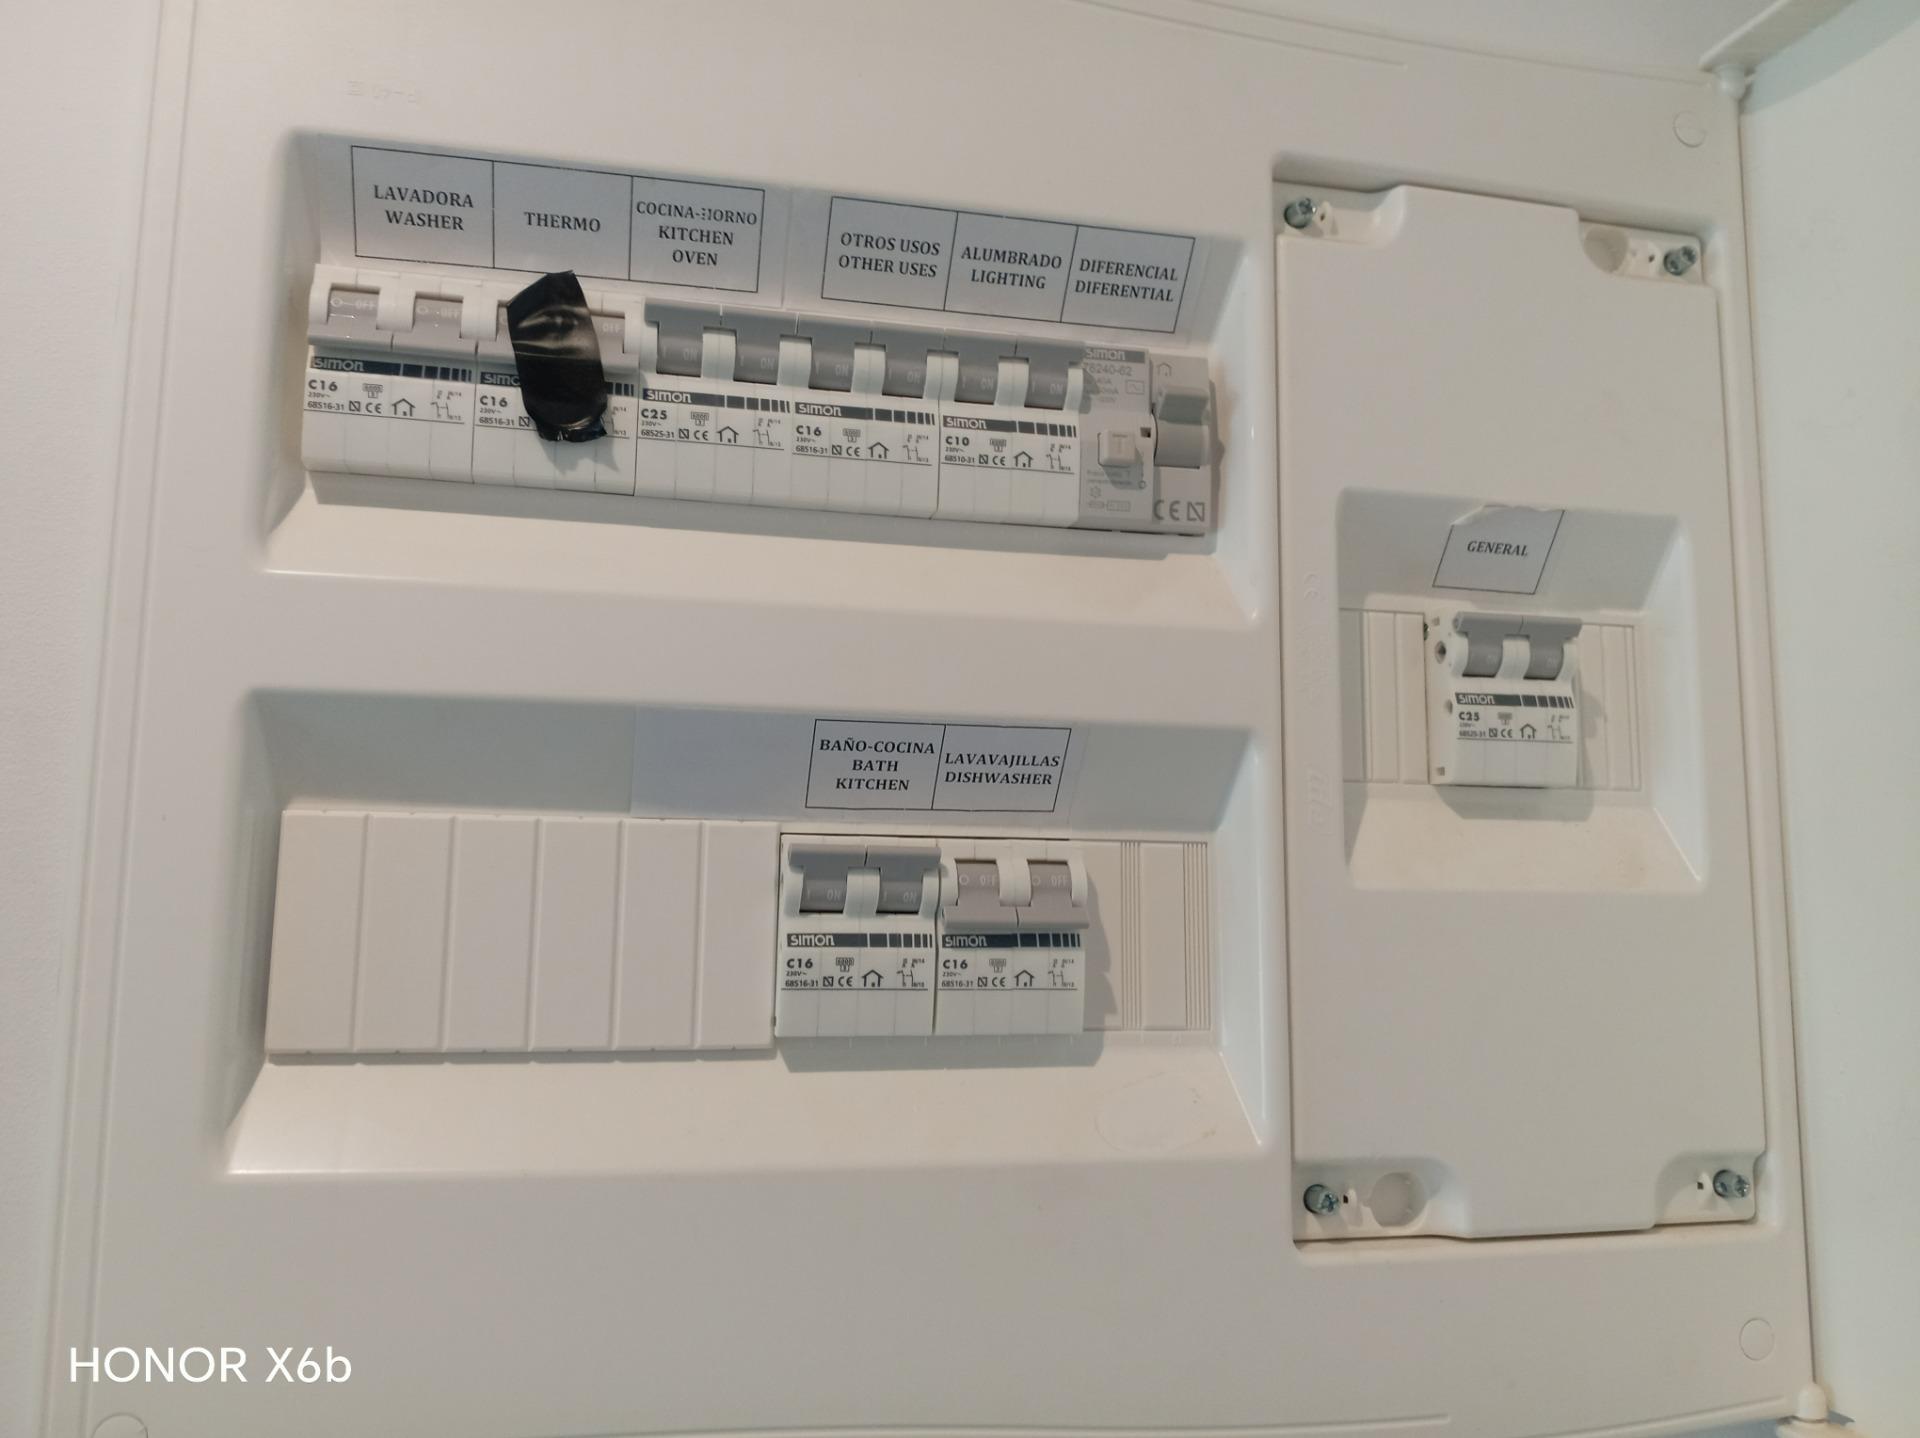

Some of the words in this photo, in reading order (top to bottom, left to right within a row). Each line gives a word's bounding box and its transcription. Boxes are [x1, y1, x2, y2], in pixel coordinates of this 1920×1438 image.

[373, 184, 474, 208] LAVADORA
[385, 210, 465, 231] WASHER
[523, 211, 601, 232] THERMO
[658, 225, 734, 246] KITCHEN
[840, 232, 896, 251] OTROS
[900, 239, 941, 256] USOS
[672, 249, 718, 266] OVEN
[961, 246, 1062, 269] ALUMBRADO
[838, 255, 894, 273] OTHER
[899, 261, 938, 278] USES
[1079, 258, 1178, 282] DIFERENCIAL
[971, 269, 1046, 289] LIGHTING
[1075, 280, 1173, 302] DIFERENTIAL
[308, 379, 338, 392] C16
[307, 400, 345, 411] 68516-31
[480, 395, 508, 408] C16
[641, 408, 668, 420] C25
[641, 430, 675, 439] 68525-31
[796, 425, 822, 436] C16
[945, 436, 970, 446] C10
[1467, 540, 1528, 557] GENERAL
[1459, 711, 1480, 721] C25
[819, 737, 935, 754] BAÑO-COCINA
[852, 760, 899, 772] BATH
[945, 753, 1061, 768] LAVAVAJILLAS
[835, 778, 910, 791] KITCHEN
[945, 771, 1052, 785] DISHWASHER
[787, 958, 813, 969] C16
[943, 960, 968, 970] C16
